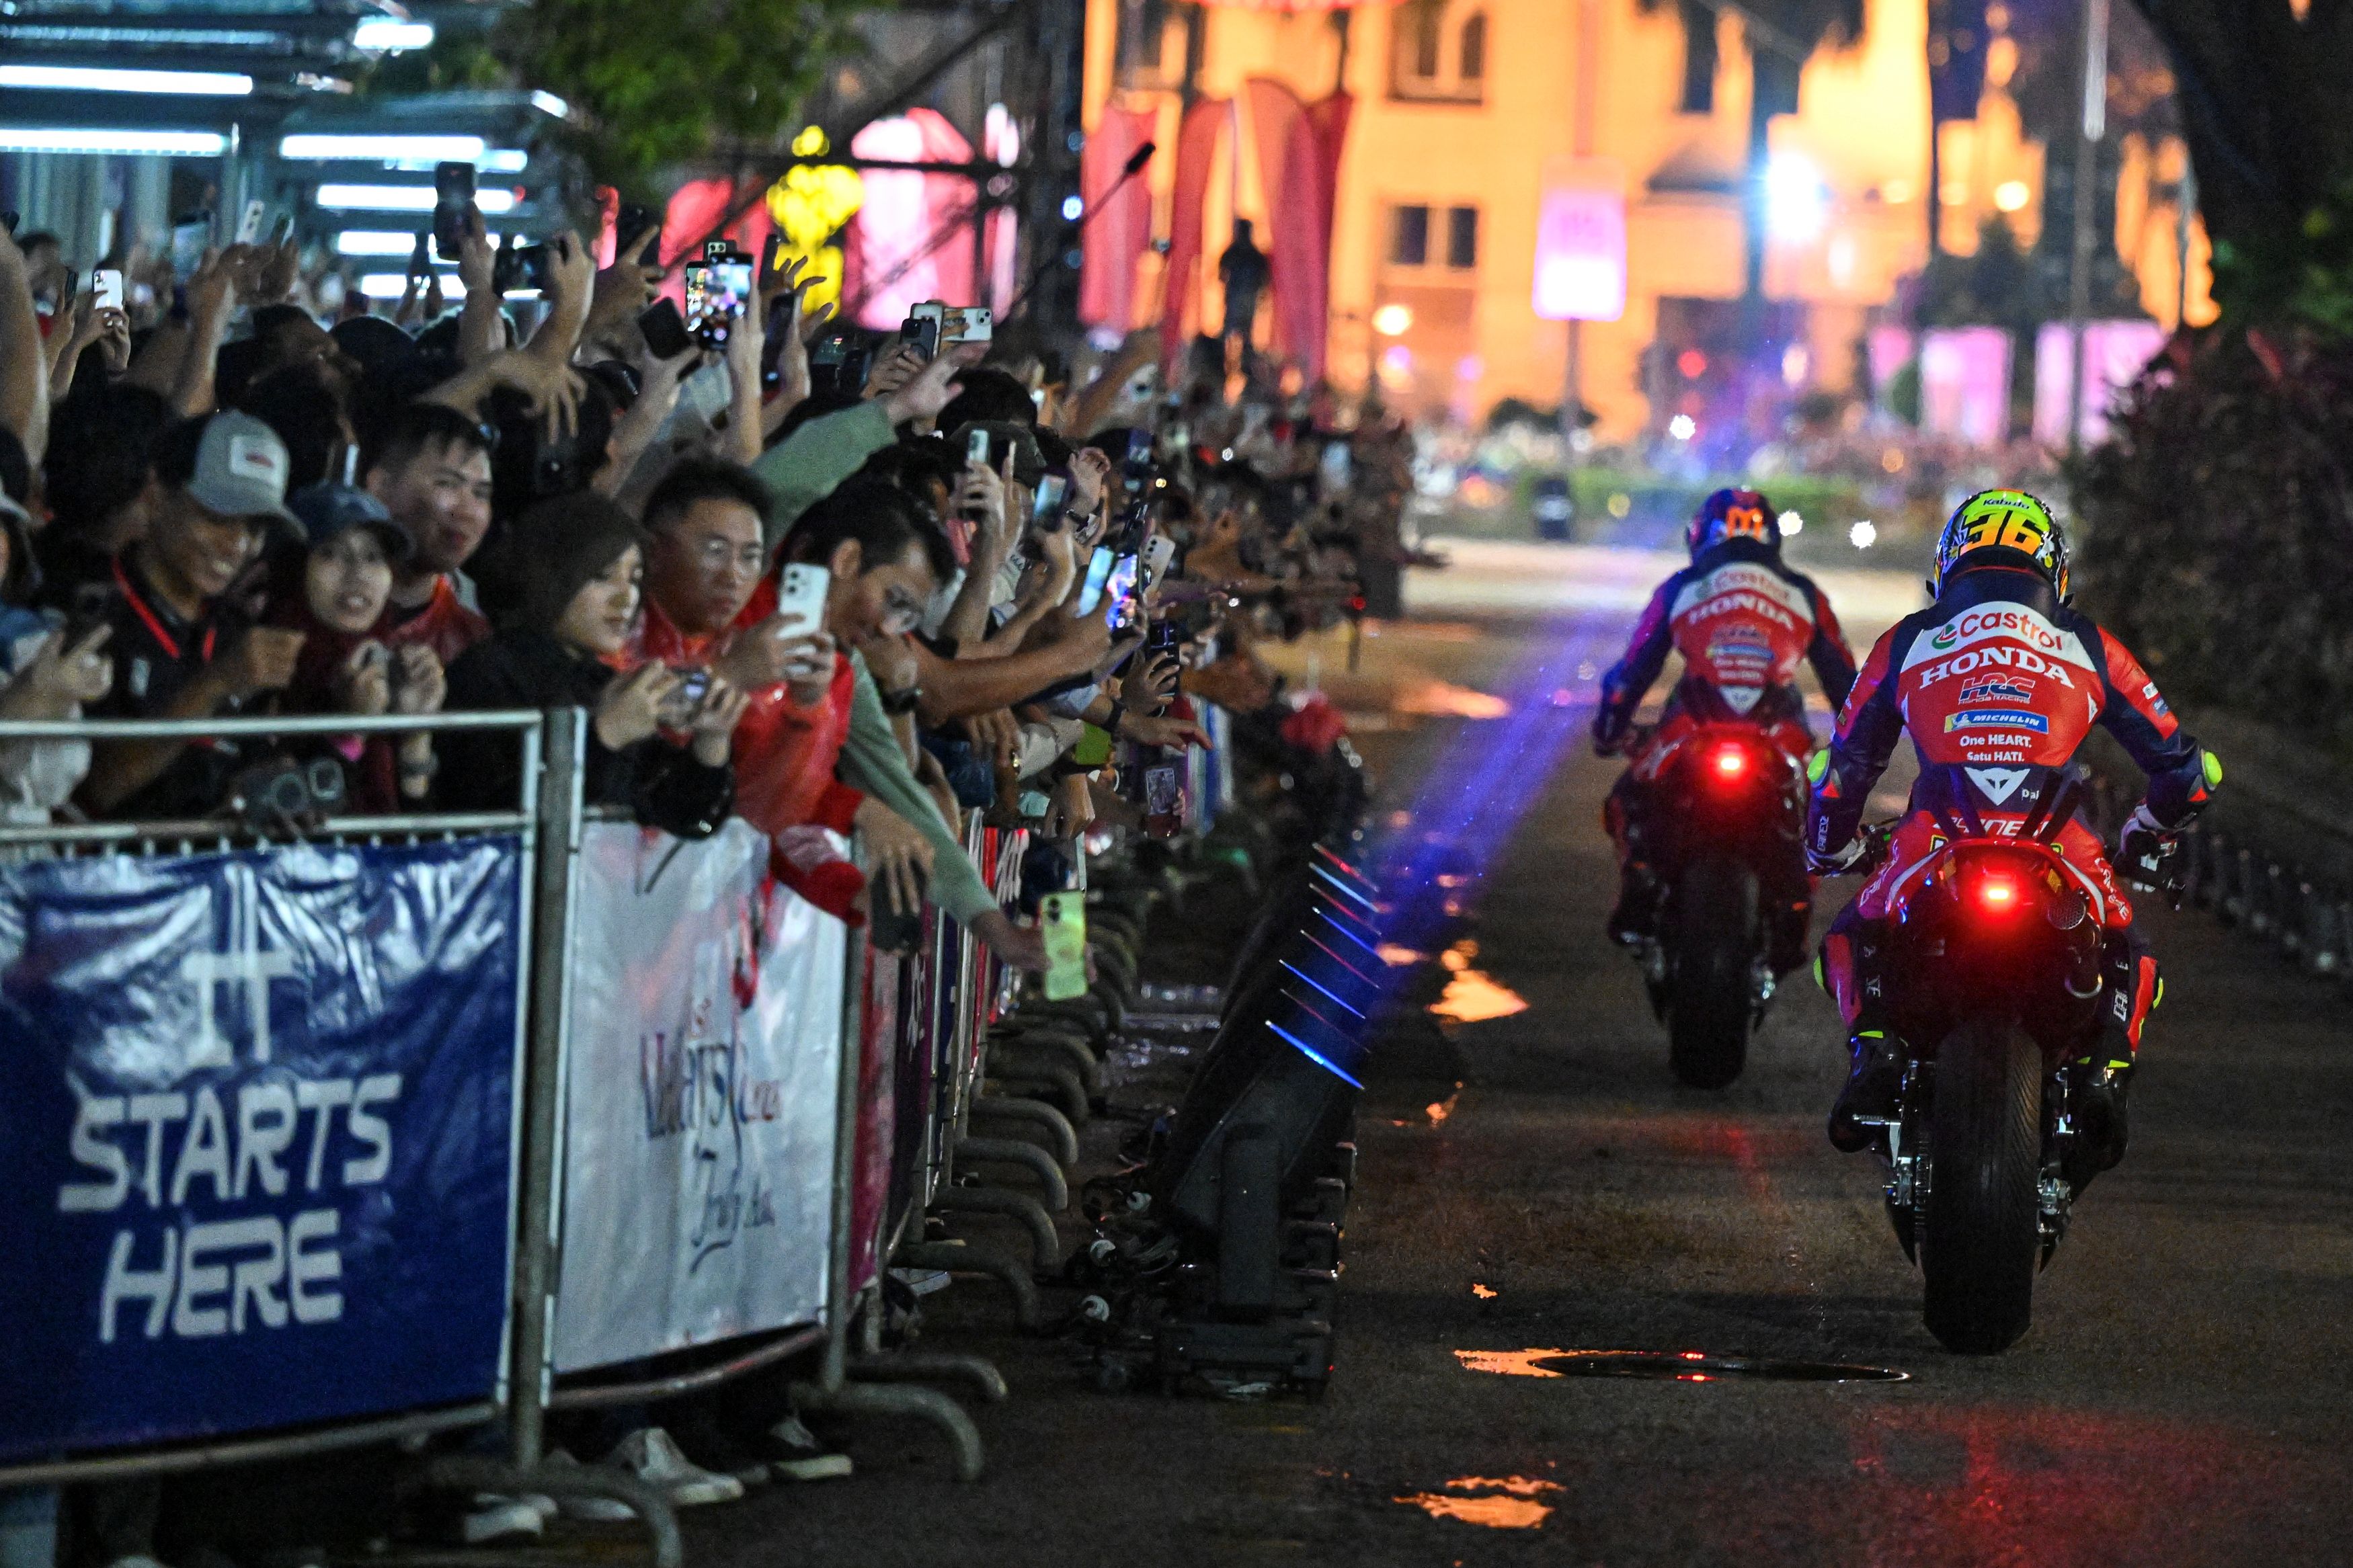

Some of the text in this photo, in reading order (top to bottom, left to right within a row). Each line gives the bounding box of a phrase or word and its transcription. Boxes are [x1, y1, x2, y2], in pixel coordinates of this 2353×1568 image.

[1959, 509, 2046, 556] 36
[1960, 611, 2063, 651] Castrol
[1919, 647, 2075, 689] HONDA
[1958, 672, 2036, 700] HRC
[1972, 714, 2040, 726] MICHELIN
[1960, 734, 2032, 748] One HEART.
[1966, 751, 2026, 762] Satu HATI.
[58, 1074, 401, 1212] STARTS
[99, 1208, 344, 1343] HERE
